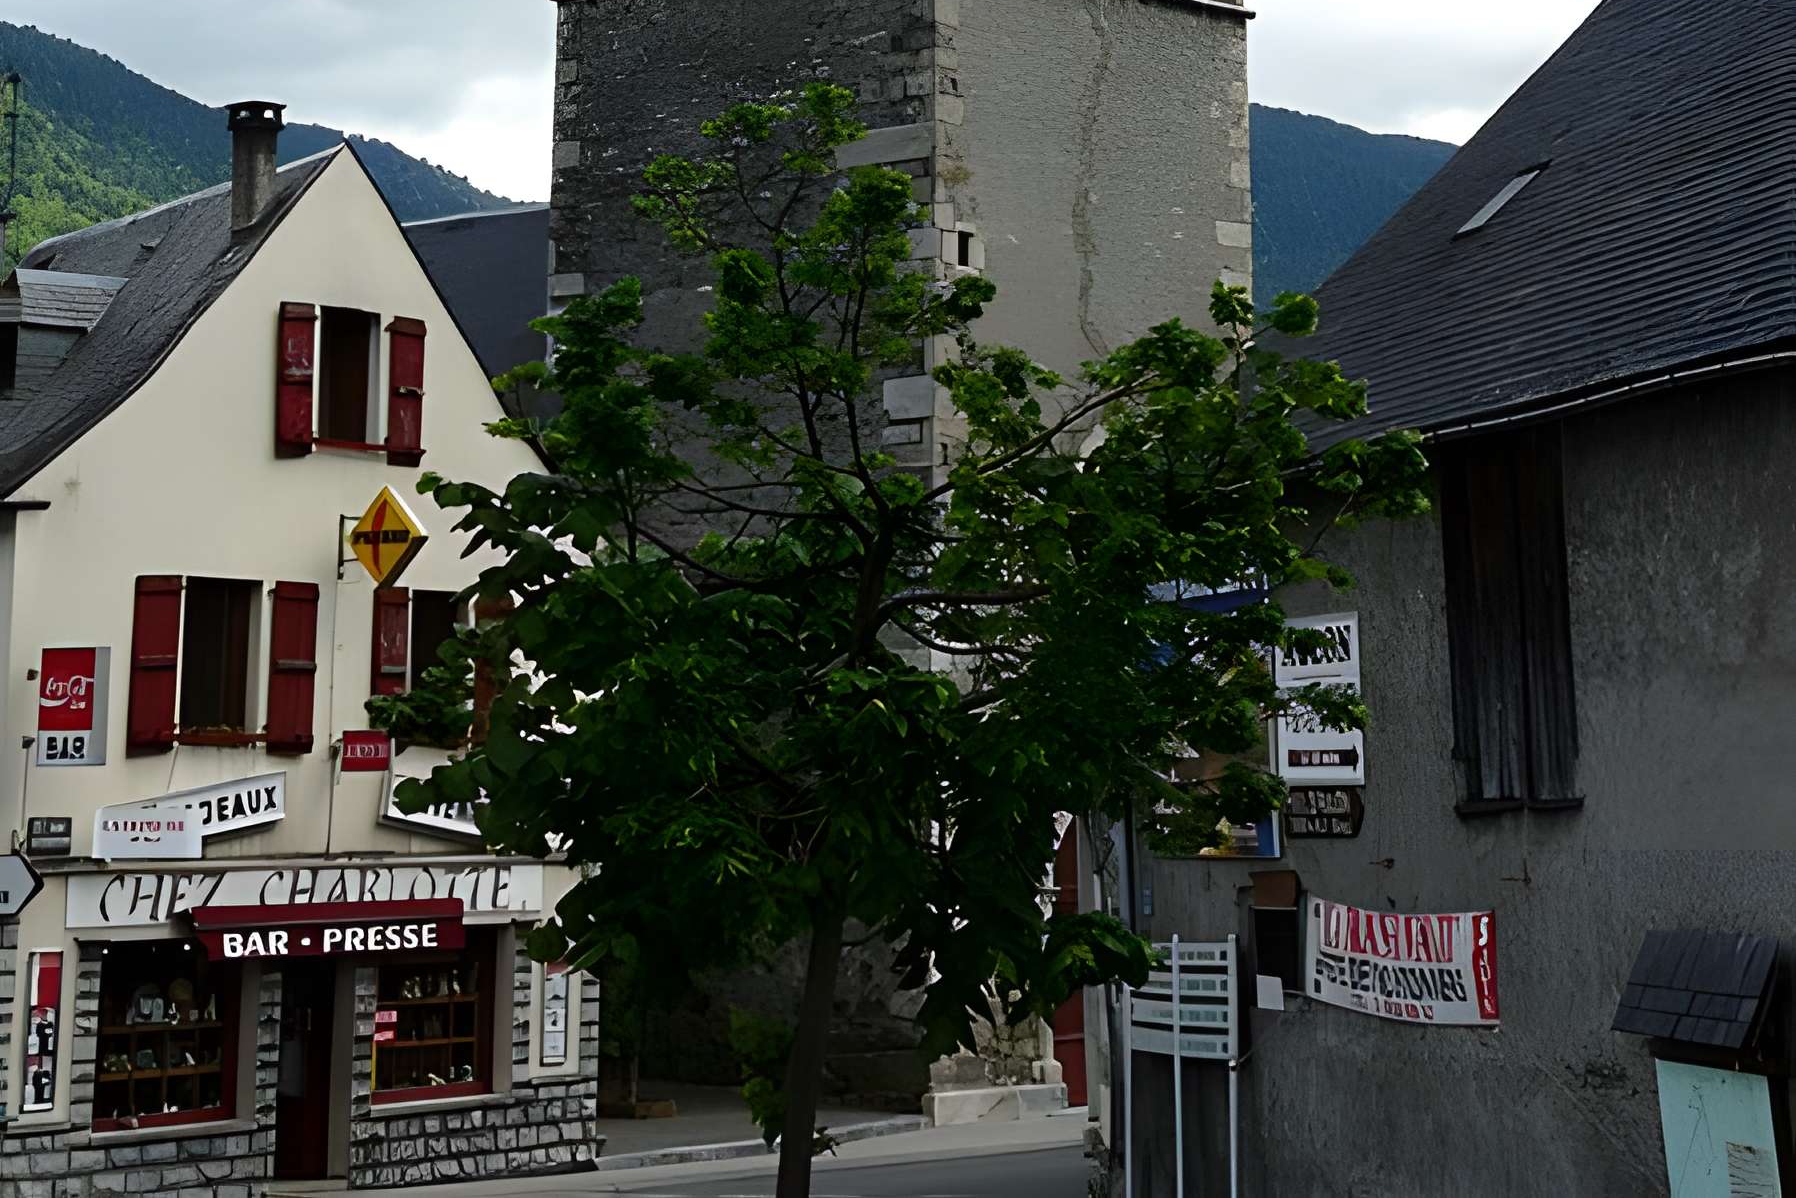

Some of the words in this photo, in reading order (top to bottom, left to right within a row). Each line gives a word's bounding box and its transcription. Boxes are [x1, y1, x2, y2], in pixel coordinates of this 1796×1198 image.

[99, 872, 227, 922] CHEZ
[223, 930, 289, 958] BAR
[323, 923, 438, 953] PRESSE
